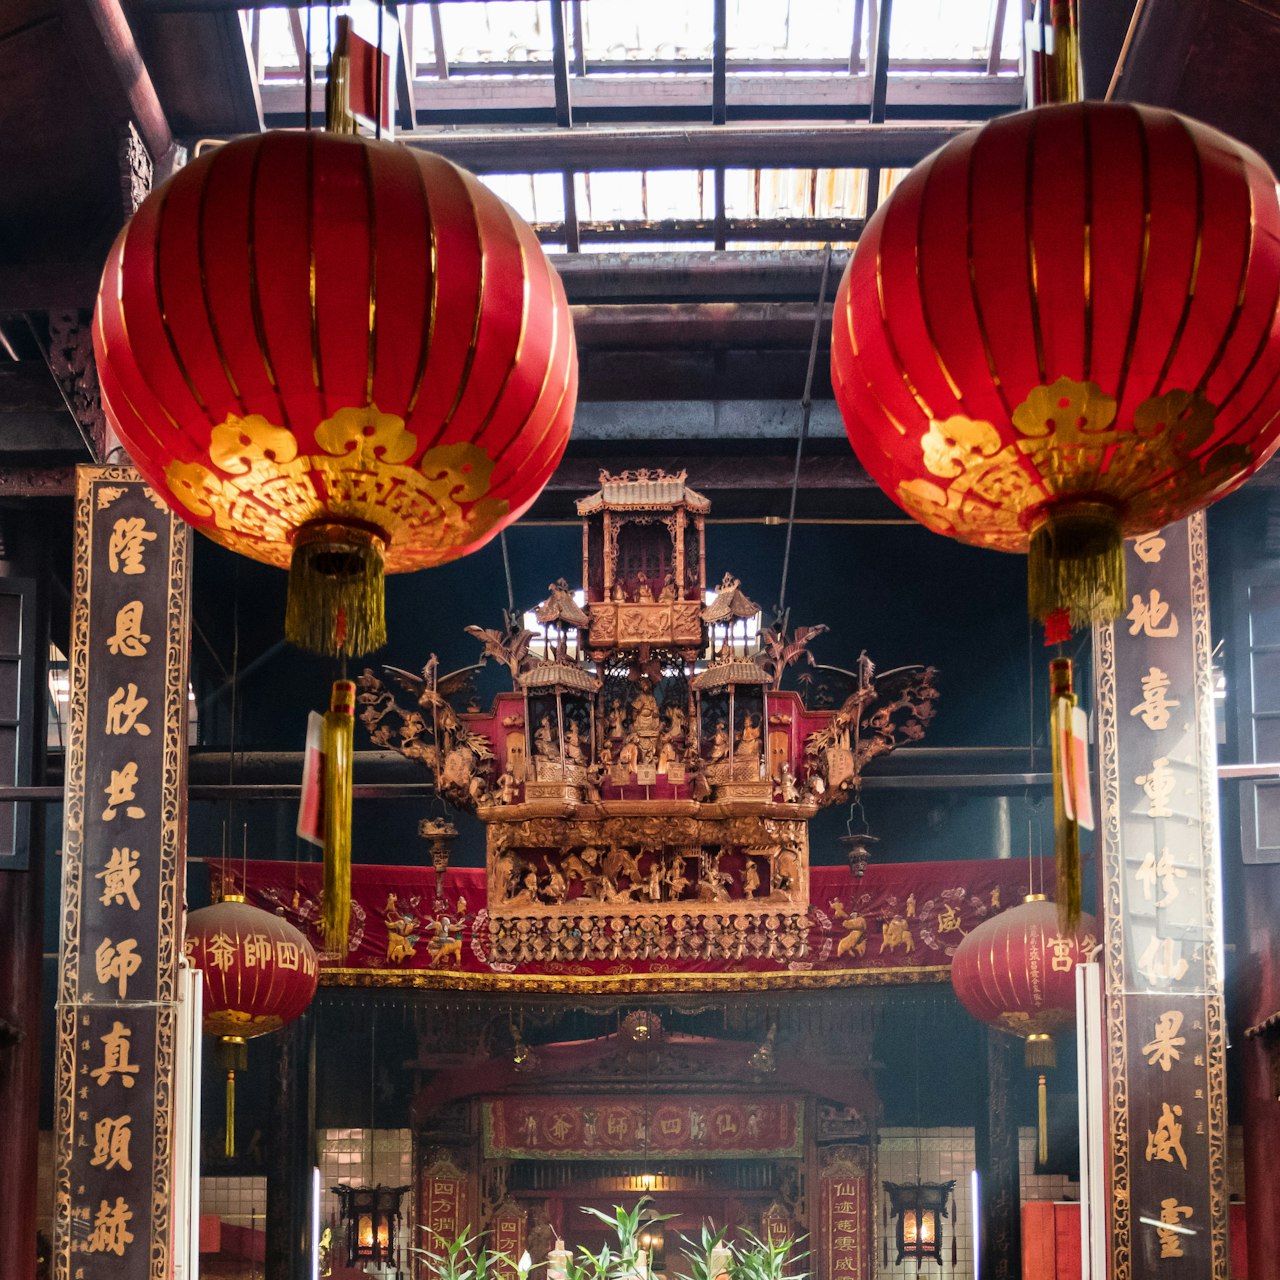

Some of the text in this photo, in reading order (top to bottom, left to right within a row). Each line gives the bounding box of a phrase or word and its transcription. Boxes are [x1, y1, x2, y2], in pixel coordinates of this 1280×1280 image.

[938, 904, 961, 933] 威
[552, 1113, 737, 1141] 仙四師爺
